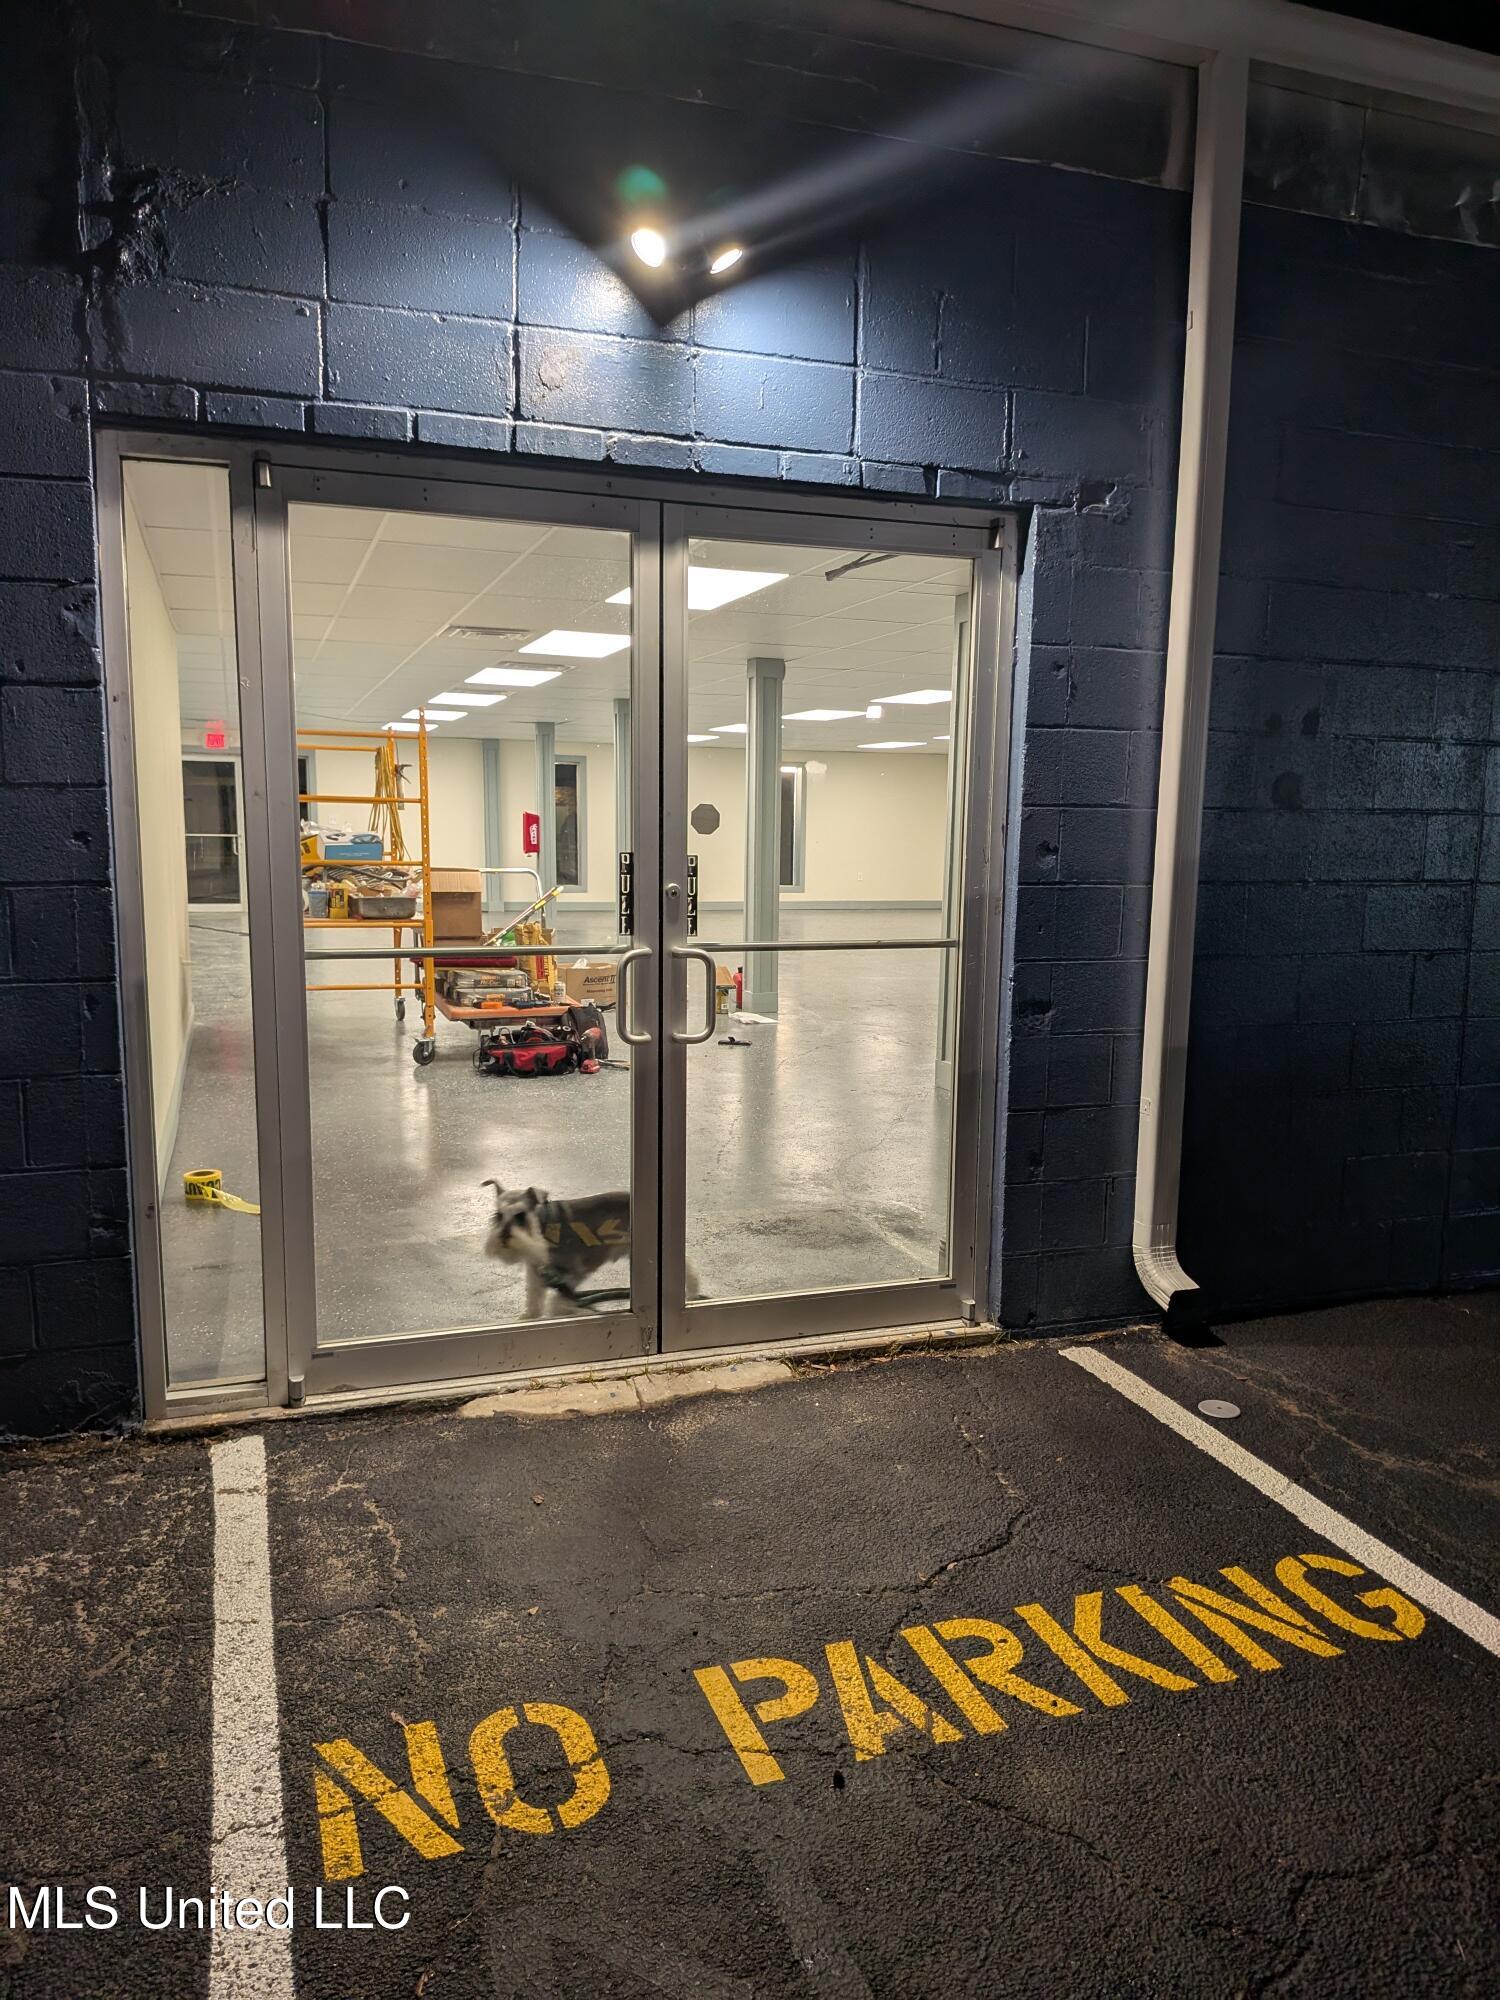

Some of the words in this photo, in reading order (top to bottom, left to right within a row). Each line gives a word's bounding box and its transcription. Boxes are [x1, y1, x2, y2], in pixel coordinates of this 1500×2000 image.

[620, 853, 631, 936] PULL
[687, 856, 697, 936] PULL
[313, 1702, 611, 1881] NO
[694, 1554, 1426, 1785] PARKING
